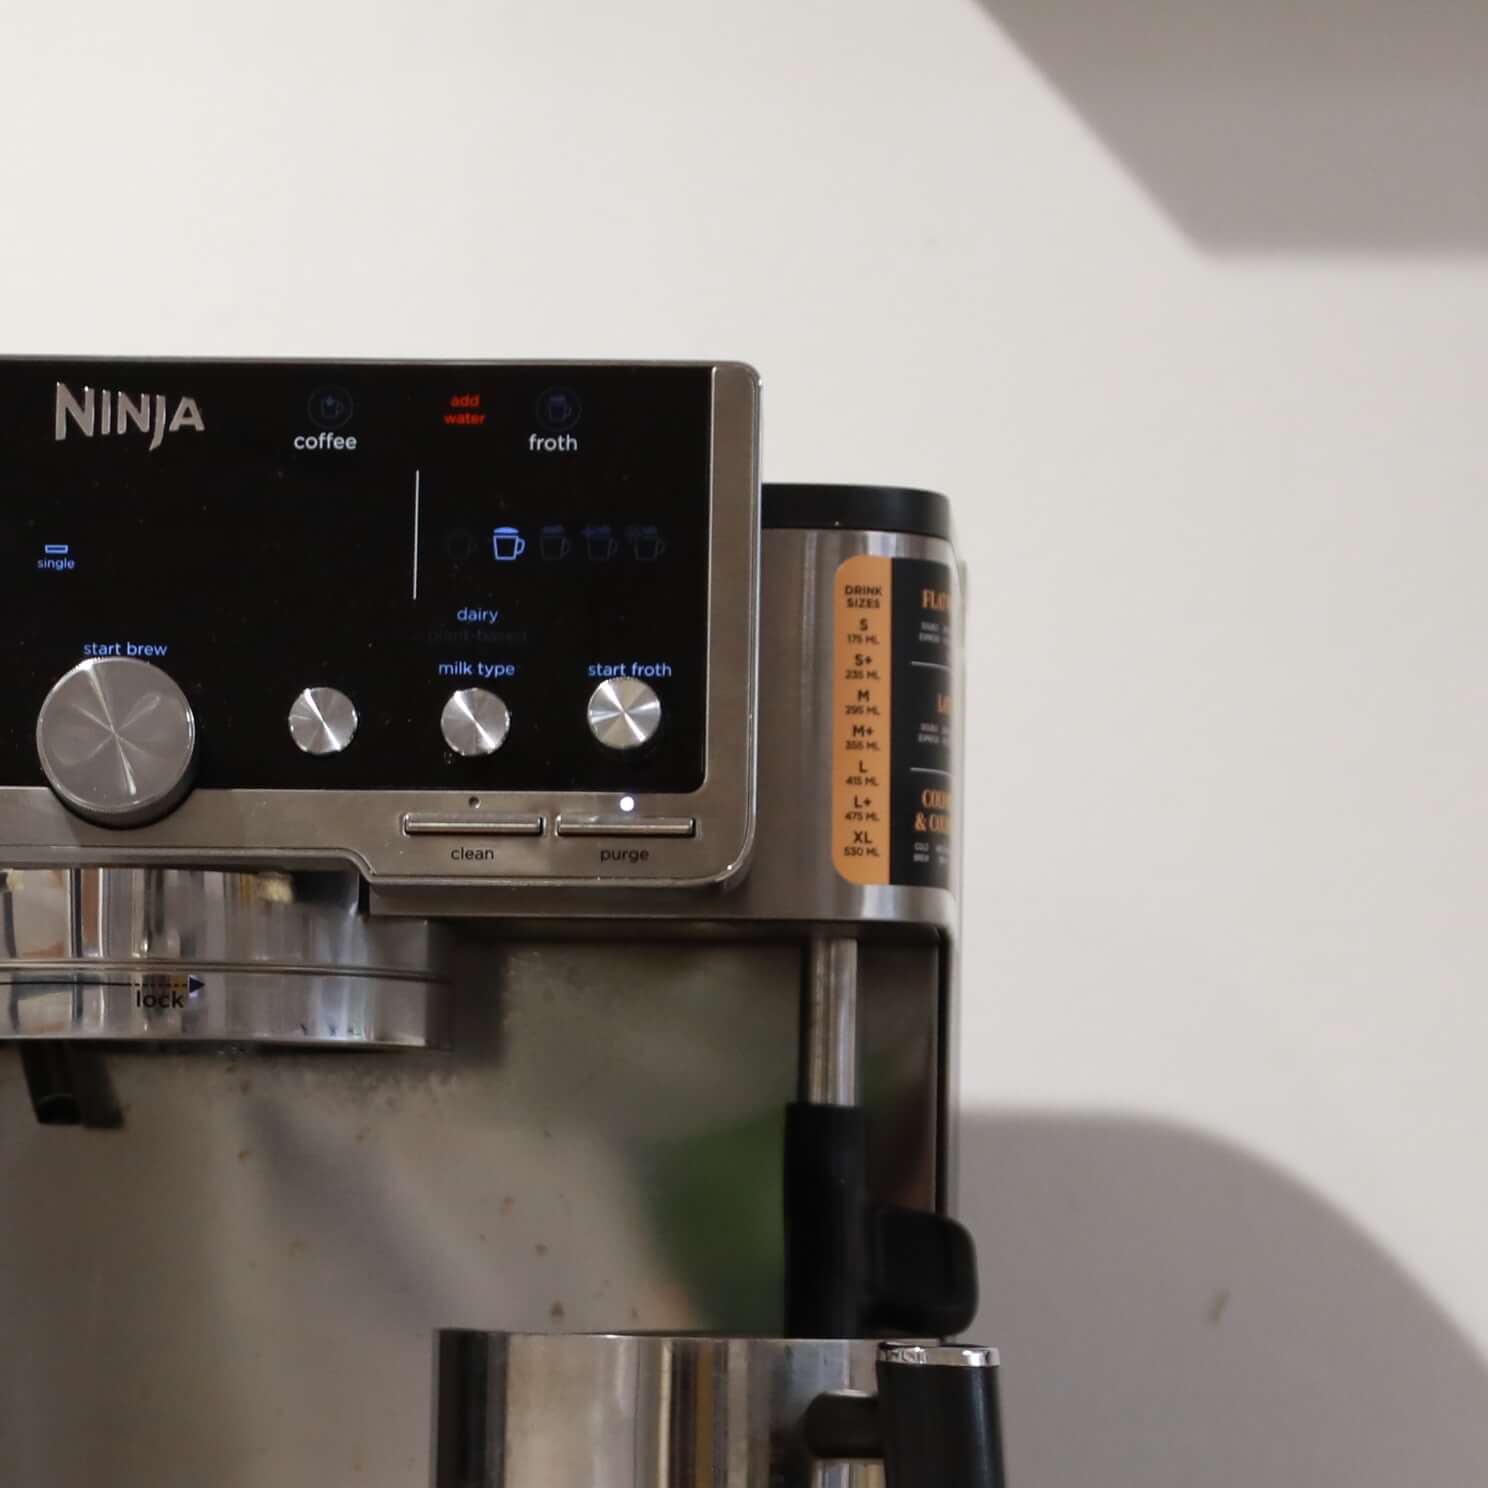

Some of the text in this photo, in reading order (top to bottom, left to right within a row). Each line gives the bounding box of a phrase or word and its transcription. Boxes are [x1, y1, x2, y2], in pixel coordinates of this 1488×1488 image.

[450, 394, 481, 408] add
[56, 380, 204, 452] NINJA
[443, 412, 486, 425] water
[293, 431, 357, 450] coffee
[528, 433, 578, 452] froth
[37, 557, 76, 571] single
[845, 585, 881, 595] DRINK
[846, 598, 880, 608] SIZES
[456, 607, 499, 624] dairy
[859, 618, 868, 631] S
[83, 640, 168, 657] start brew
[855, 653, 872, 666] S+
[438, 660, 516, 678] milk type
[587, 661, 672, 677] start froth
[857, 689, 870, 701] M
[852, 725, 873, 736] M+
[858, 760, 868, 773] L
[854, 795, 871, 808] L+
[845, 811, 863, 820] 475
[854, 831, 872, 843] XL
[450, 847, 495, 861] clean
[599, 849, 650, 864] purge
[844, 846, 863, 856] 530
[136, 989, 185, 1009] lock
